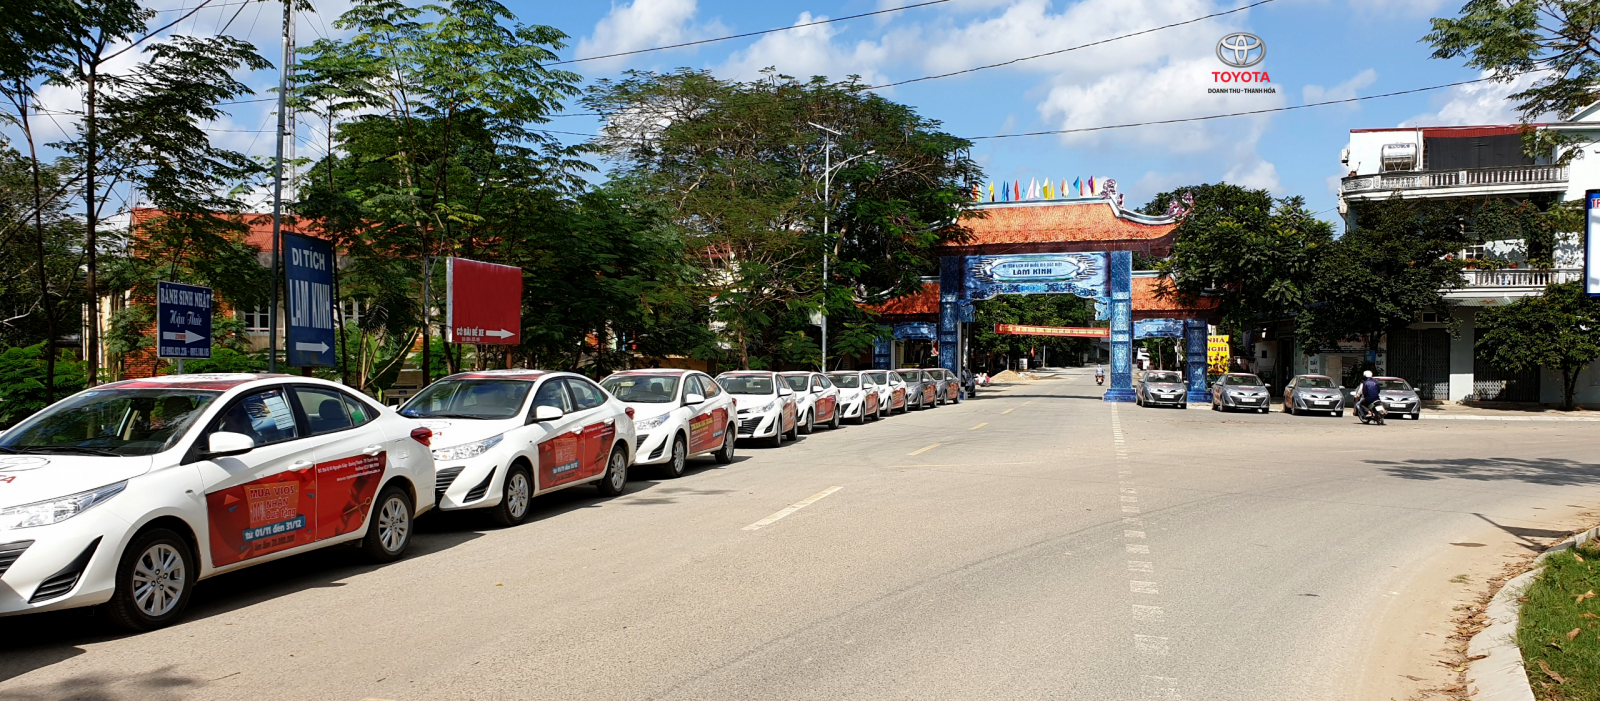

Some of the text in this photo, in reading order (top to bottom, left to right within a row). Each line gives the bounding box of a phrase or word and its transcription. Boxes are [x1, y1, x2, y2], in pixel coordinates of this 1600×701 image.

[292, 246, 326, 271] DI TÍCH
[160, 284, 210, 311] BÁNH SINH NHẬT
[289, 278, 332, 330] LAM KINH
[250, 485, 295, 499] MUA VIOS
[266, 497, 289, 510] NHẬN
[280, 506, 296, 519] tặng
[244, 519, 302, 540] từ 01/11 đến 31/12
